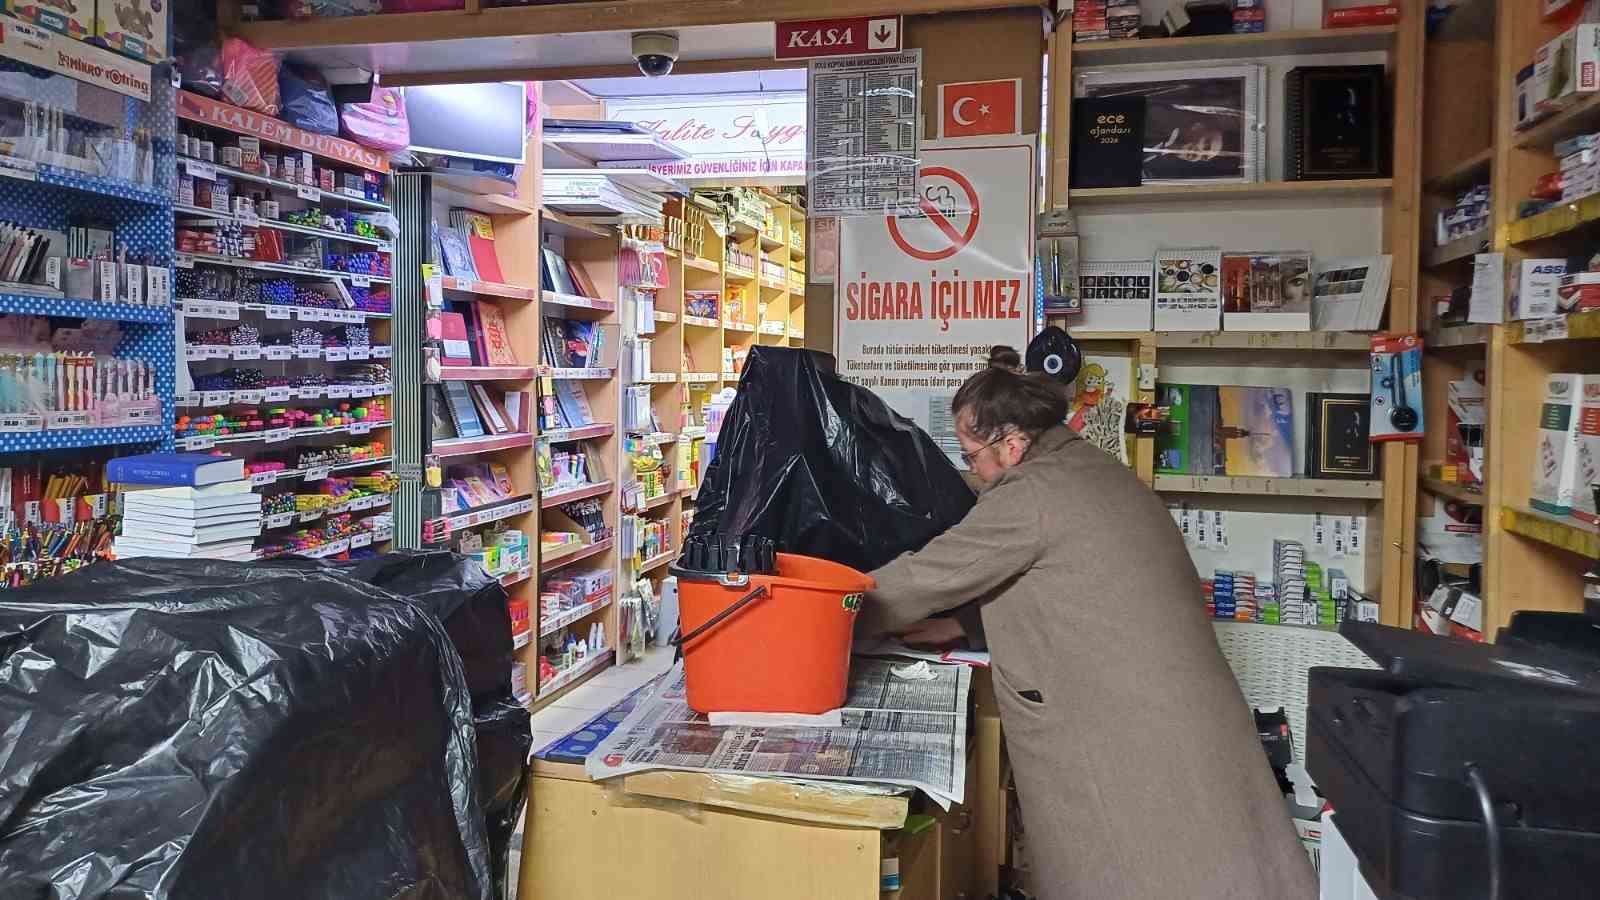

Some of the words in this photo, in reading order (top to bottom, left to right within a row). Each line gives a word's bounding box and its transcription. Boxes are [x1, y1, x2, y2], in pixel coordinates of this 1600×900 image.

[787, 27, 854, 48] KASA
[213, 105, 293, 143] KALEM
[1097, 115, 1125, 124] ece
[780, 159, 809, 172] KAPA
[847, 271, 923, 320] SİGARA
[931, 269, 1021, 331] İÇİLMEZ
[862, 344, 884, 355] Burada
[886, 344, 903, 355] tütün
[931, 344, 969, 355] tüketilmesi
[884, 362, 892, 370] ve
[894, 360, 937, 371] tüketilmesine
[939, 361, 950, 373] göz
